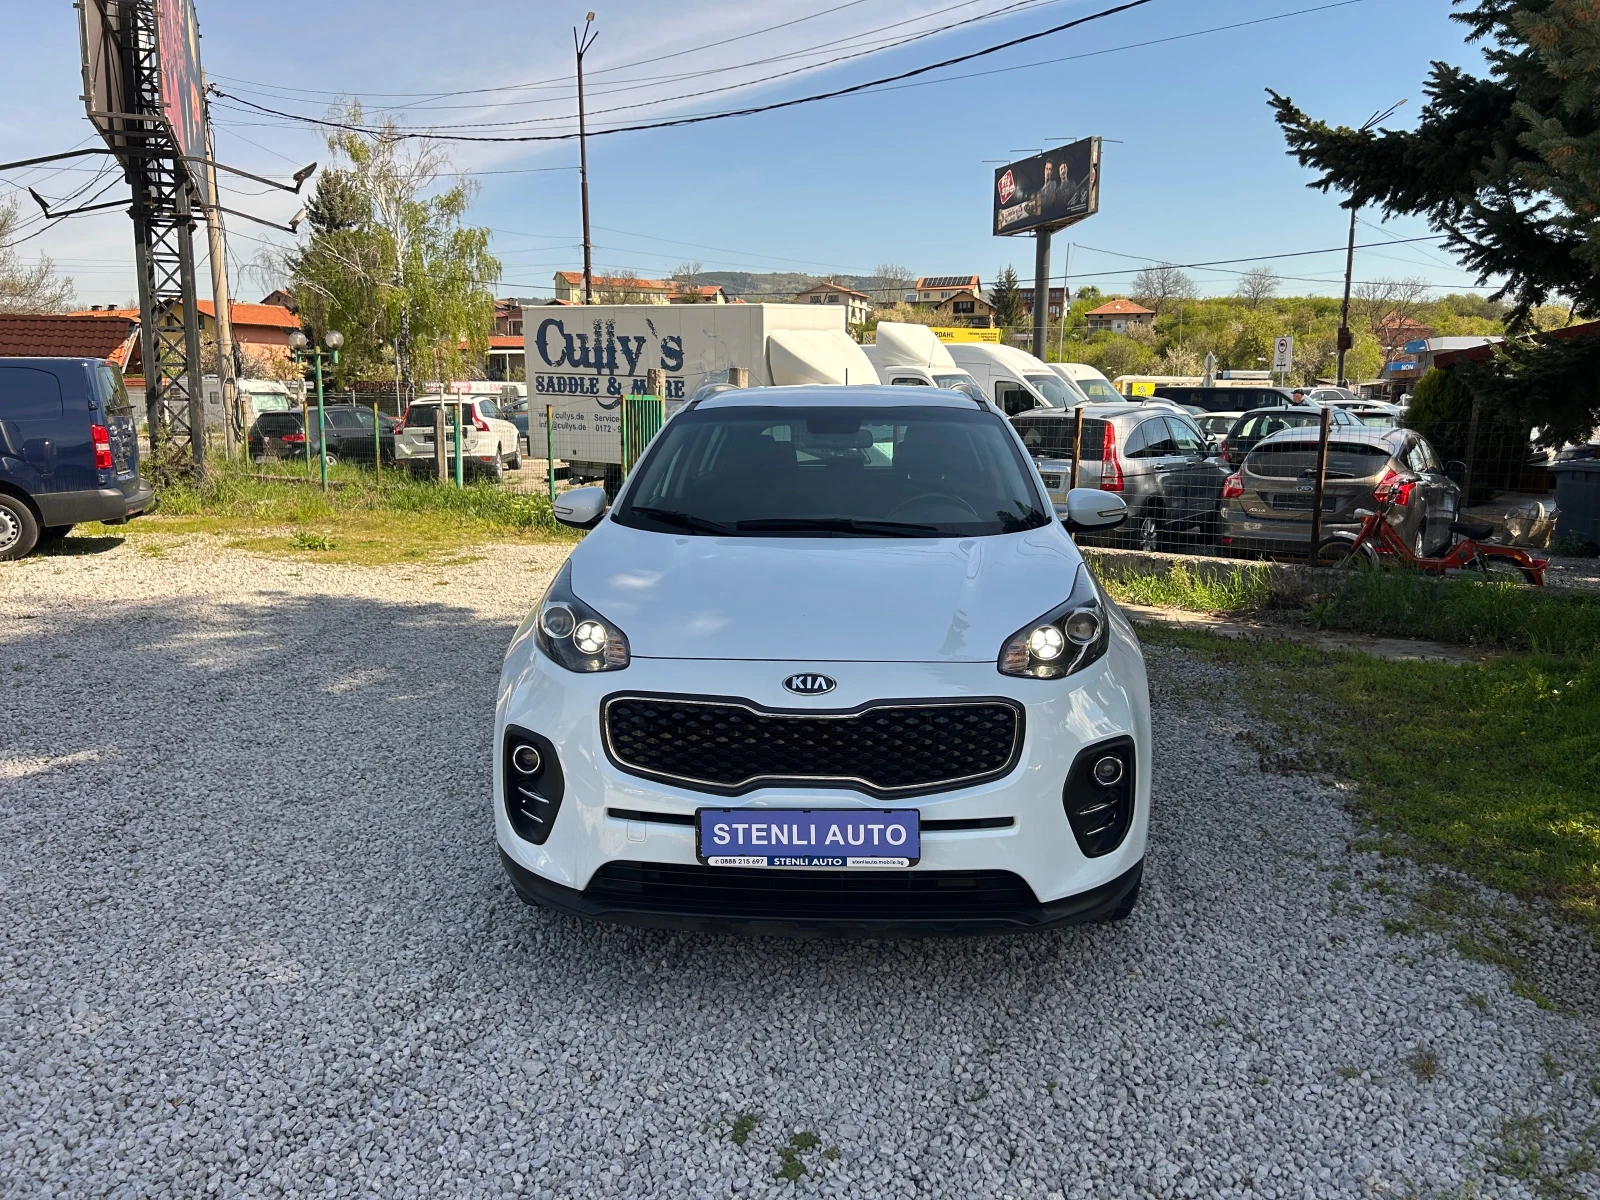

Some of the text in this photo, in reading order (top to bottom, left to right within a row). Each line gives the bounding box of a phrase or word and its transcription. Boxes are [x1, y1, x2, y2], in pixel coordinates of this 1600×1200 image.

[535, 375, 685, 398] SADDLE & MRE
[538, 421, 587, 432] inf@cullys.de
[595, 424, 612, 433] 0172
[791, 676, 828, 690] KIA
[712, 823, 907, 846] STENLI AUTO
[773, 857, 843, 866] STENLI AUTO
[851, 859, 905, 867] stenliauto.mobile.bg
